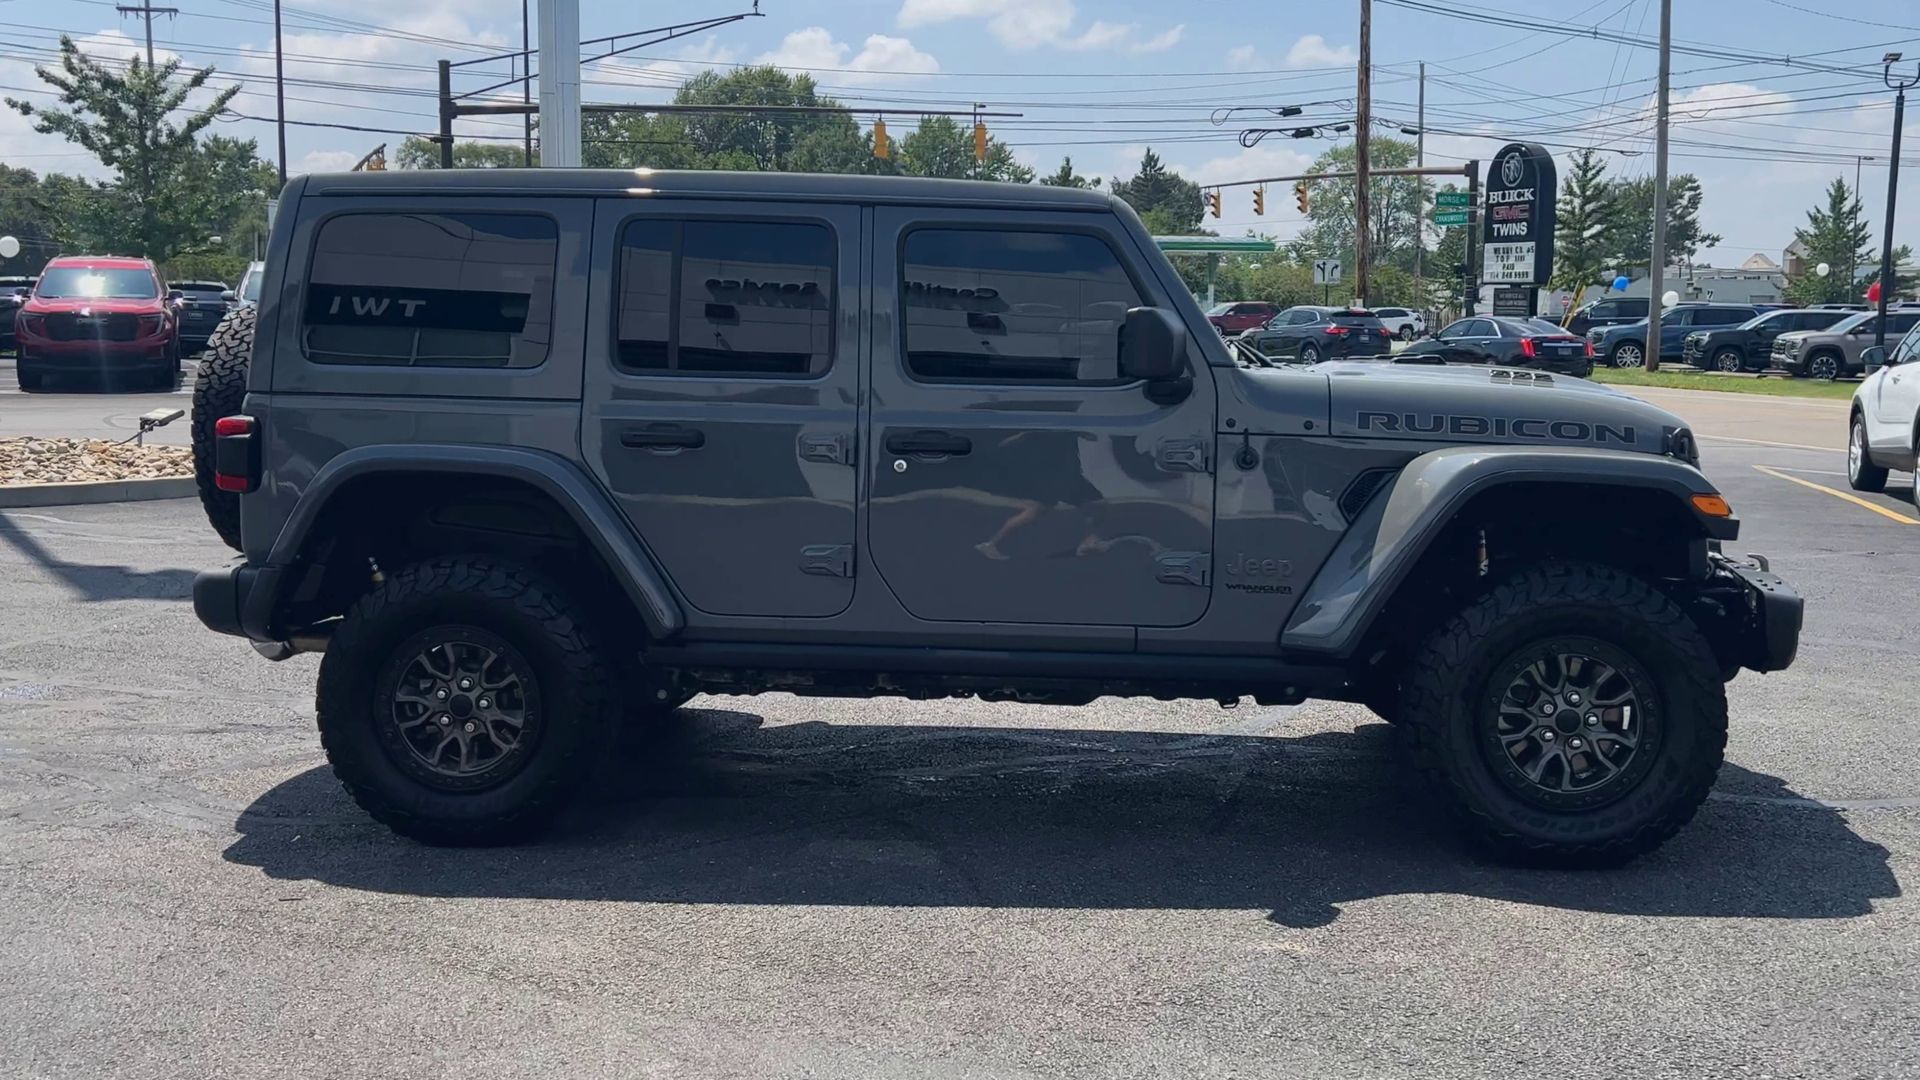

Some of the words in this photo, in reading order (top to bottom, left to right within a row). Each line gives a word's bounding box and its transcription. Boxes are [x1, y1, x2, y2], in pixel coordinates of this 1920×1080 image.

[1488, 188, 1535, 203] BUICK
[1493, 204, 1529, 220] GMC
[1492, 221, 1528, 237] TWINS
[1356, 410, 1638, 445] RUBICON
[1224, 552, 1294, 578] Jeep
[1224, 583, 1293, 593] WRANGLER
